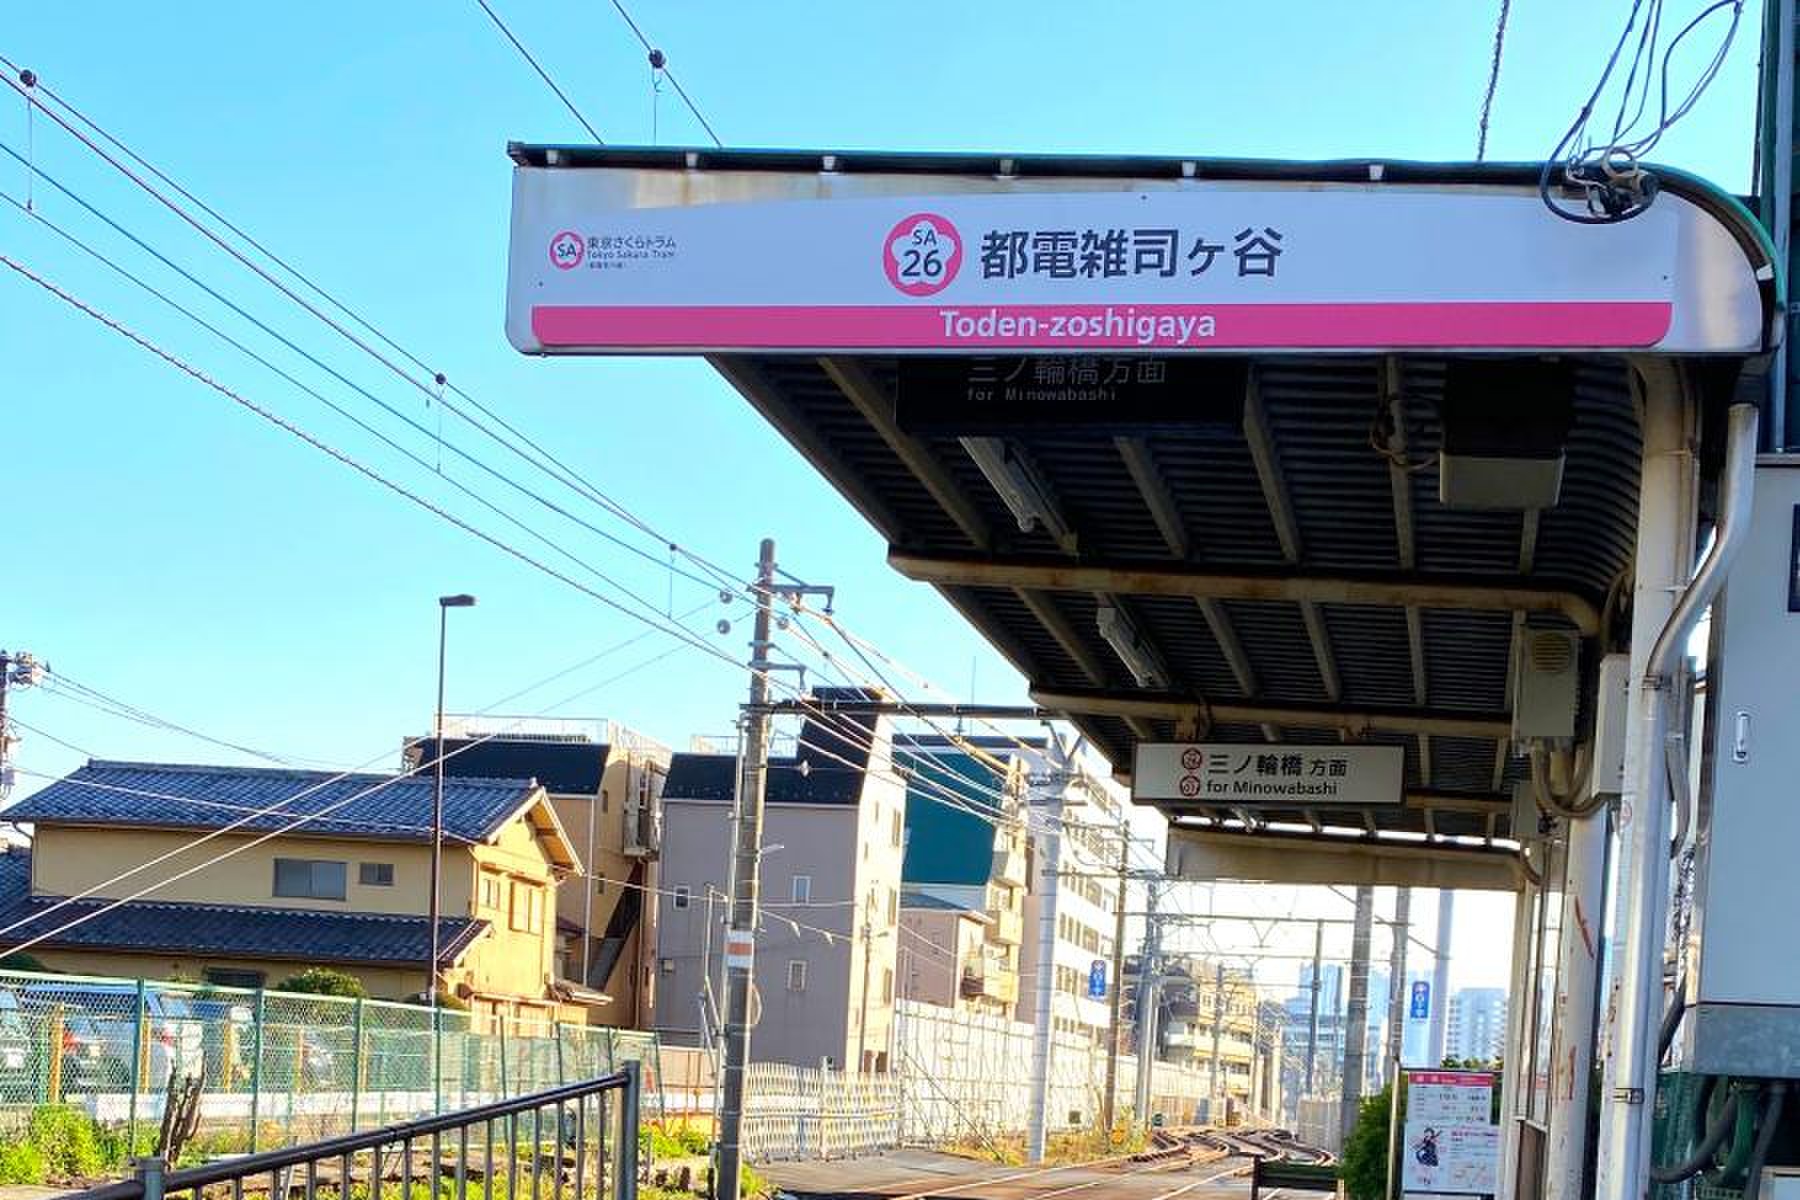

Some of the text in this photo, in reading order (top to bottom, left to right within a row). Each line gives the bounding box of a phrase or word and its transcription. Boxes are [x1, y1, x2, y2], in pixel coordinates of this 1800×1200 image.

[587, 236, 677, 250] 東京さくらトラム
[912, 228, 937, 246] SA
[557, 242, 577, 258] SA
[588, 250, 614, 259] Tokyo
[902, 249, 943, 278] 26
[939, 308, 1217, 345] Toden-zoshigaya
[968, 388, 1119, 401] for Minowabashi
[1206, 780, 1338, 795] for Minowabashi
